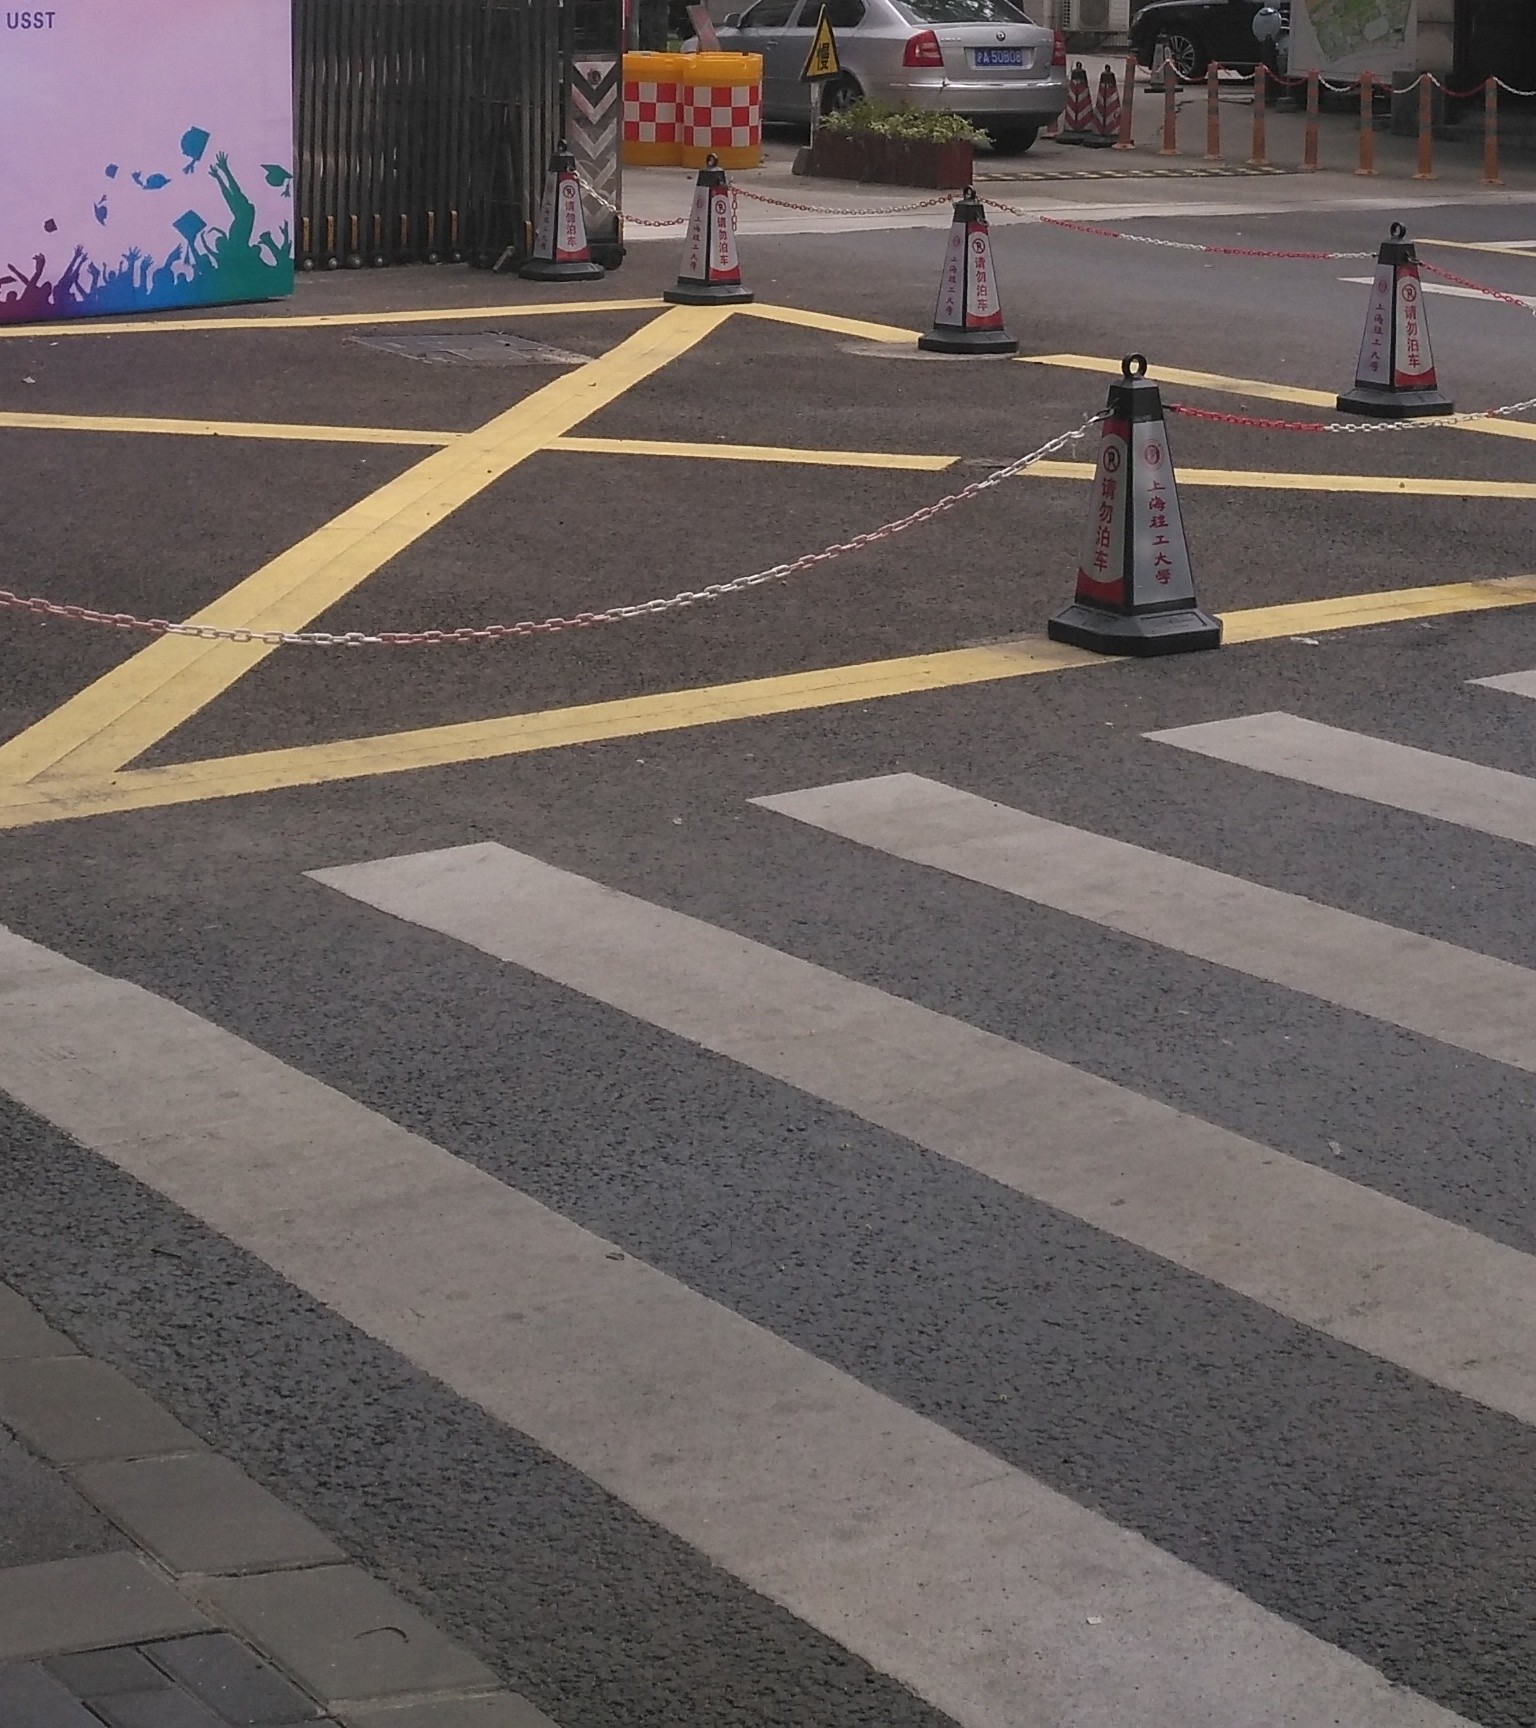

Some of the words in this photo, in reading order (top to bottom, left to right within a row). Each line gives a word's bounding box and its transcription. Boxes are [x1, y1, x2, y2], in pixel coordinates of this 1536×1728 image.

[7, 11, 56, 29] USST
[816, 41, 830, 71] 慢
[717, 217, 729, 265] 请勿泊车
[974, 256, 989, 311] 请勿泊车
[1404, 305, 1420, 368] 请勿泊车
[1094, 478, 1117, 573] 请勿泊车
